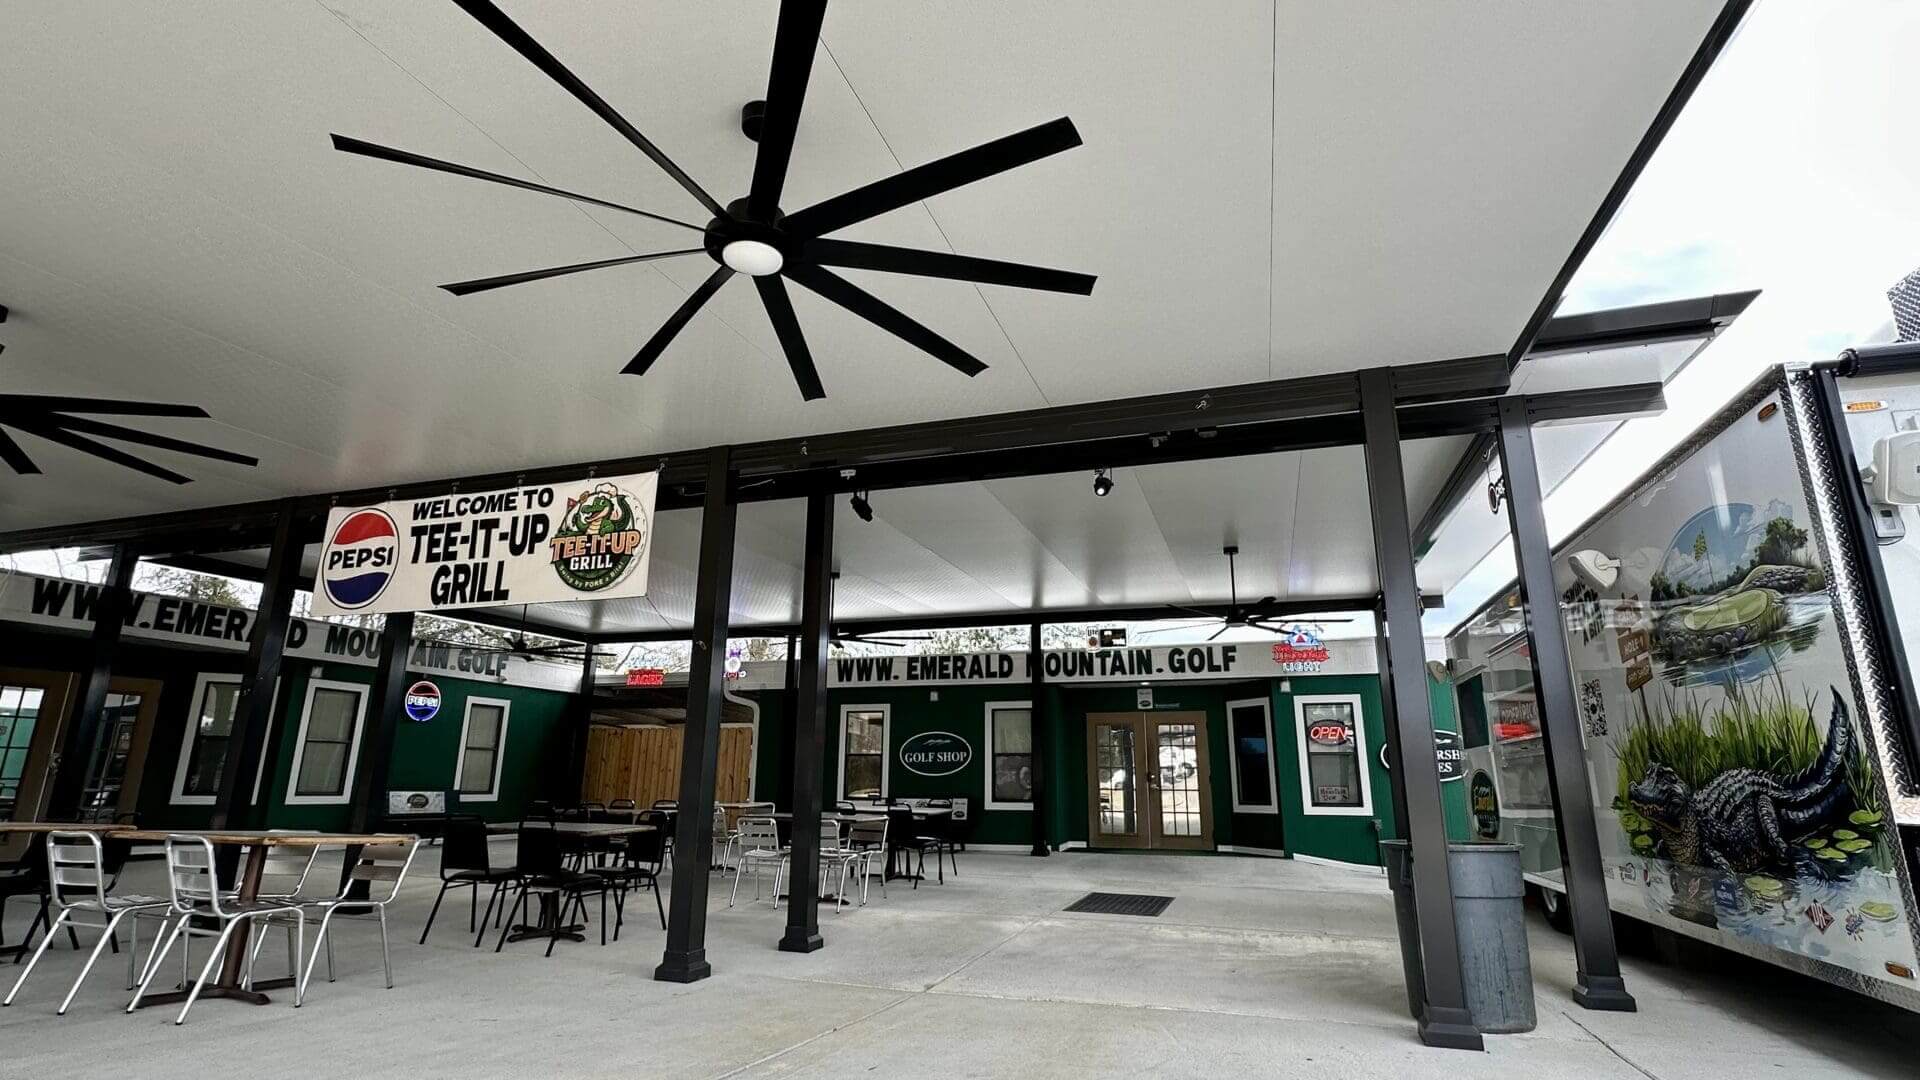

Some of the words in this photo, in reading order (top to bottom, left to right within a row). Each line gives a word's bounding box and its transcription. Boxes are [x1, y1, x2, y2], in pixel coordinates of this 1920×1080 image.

[412, 492, 519, 520] WELCOME
[523, 487, 554, 509] TO
[411, 513, 550, 564] TEE-IT-UP
[551, 529, 641, 562] TEE-IT-UP
[328, 546, 394, 570] PEPSI
[569, 554, 613, 571] GRILL
[431, 561, 510, 605] GRILL
[1310, 726, 1347, 740] OPEN
[904, 752, 935, 762] GOLF
[937, 751, 967, 762] SHOP
